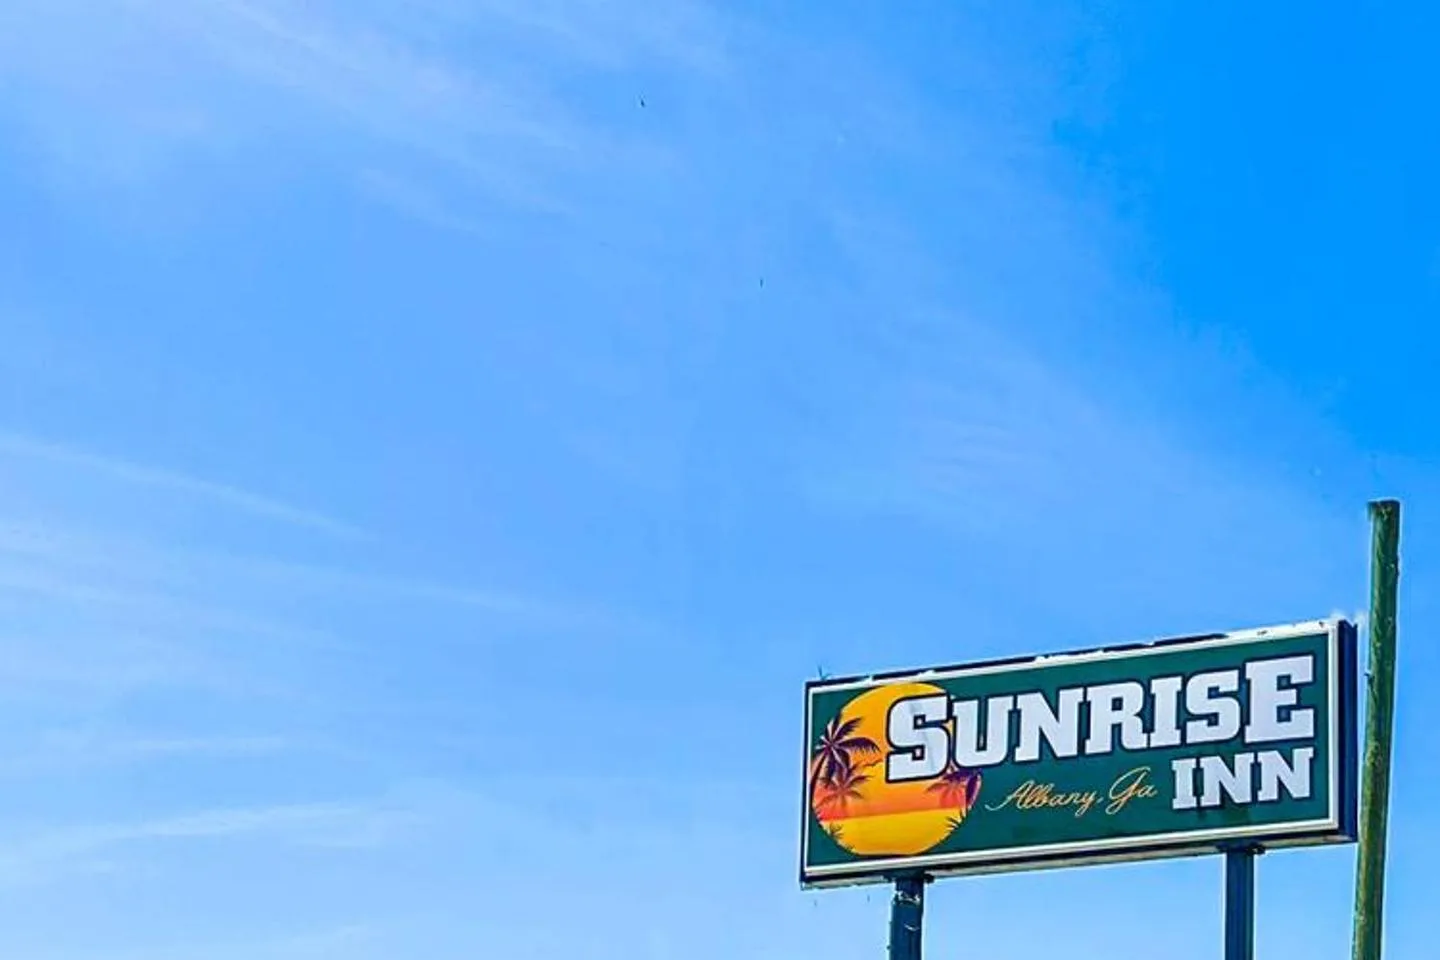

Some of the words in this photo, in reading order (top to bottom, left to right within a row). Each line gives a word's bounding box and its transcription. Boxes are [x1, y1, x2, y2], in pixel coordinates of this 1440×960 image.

[886, 654, 1315, 782] SUNRISE
[1105, 766, 1158, 815] Ga
[1171, 747, 1313, 810] INN
